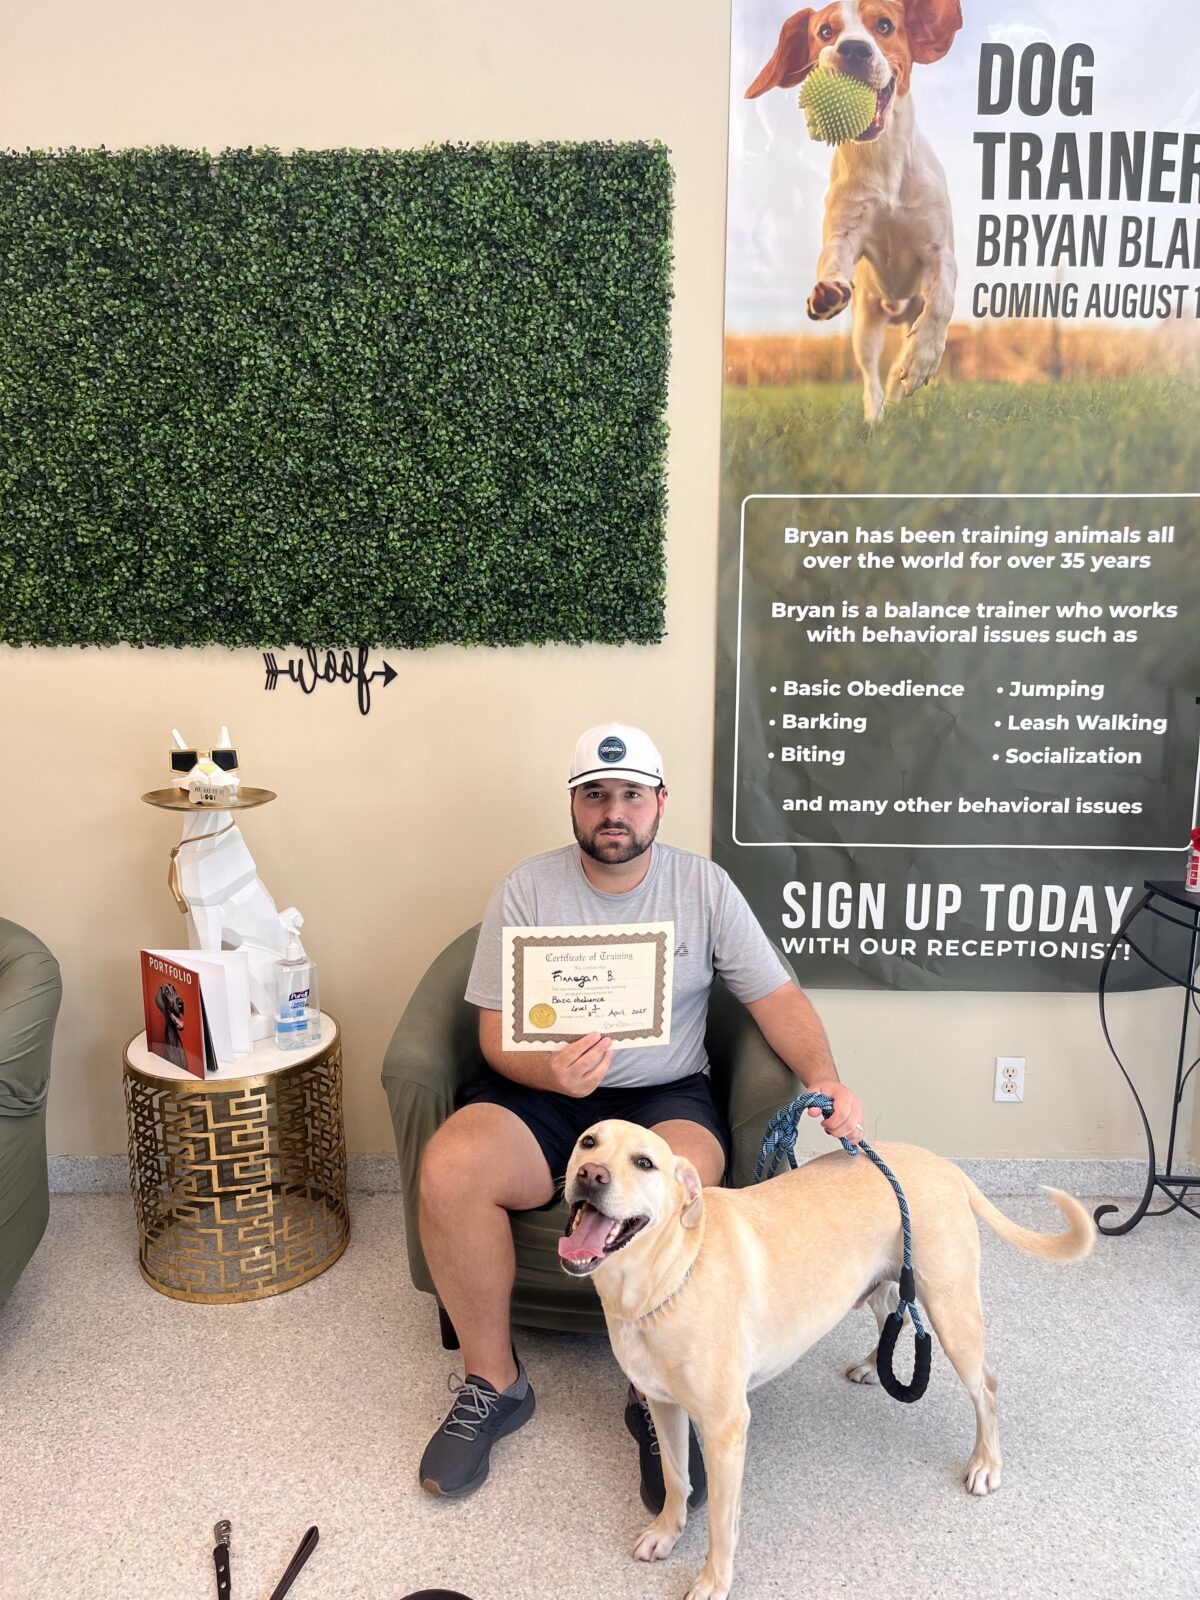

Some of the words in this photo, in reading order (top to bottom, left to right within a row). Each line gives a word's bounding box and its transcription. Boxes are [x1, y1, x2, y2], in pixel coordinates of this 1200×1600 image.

[978, 43, 1094, 116] DOG
[974, 131, 1200, 203] TRAINER
[977, 215, 1107, 266] BRYAN
[1119, 216, 1200, 268] BLA
[973, 283, 1078, 317] COMING
[1084, 284, 1189, 319] AUGUST
[785, 528, 848, 547] Bryan
[856, 527, 894, 543] has
[901, 526, 955, 543] been
[962, 525, 1048, 547] training
[1055, 525, 1141, 543] animals
[1147, 526, 1174, 543] all
[803, 556, 852, 568] over
[857, 552, 894, 568] the
[901, 552, 964, 568] world
[970, 552, 1002, 568] for
[1007, 556, 1055, 568] over
[1060, 553, 1085, 568] 35
[1090, 556, 1151, 572] years
[772, 603, 834, 621] Bryan
[842, 600, 859, 618] is
[866, 606, 877, 618] a
[885, 602, 970, 618] balance
[976, 600, 1050, 618] trainer
[1056, 602, 1103, 618] who
[1109, 602, 1177, 618] works
[807, 625, 855, 642] with
[863, 625, 977, 642] behavioral
[984, 625, 1050, 642] issues
[1056, 626, 1106, 642] such
[1113, 630, 1137, 642] as
[784, 679, 841, 696] Basic
[847, 679, 964, 696] Obedience
[1009, 680, 1104, 700] Jumping
[783, 713, 866, 733] Barking
[1009, 715, 1069, 730] Leash
[1076, 714, 1167, 734] Walking
[782, 745, 845, 765] Biting
[1006, 747, 1141, 763] Socialization
[783, 796, 822, 811] and
[829, 800, 888, 815] many
[894, 797, 952, 812] other
[958, 797, 1069, 813] behavioral
[1076, 797, 1142, 813] issues
[782, 881, 885, 929] SIGN
[906, 884, 961, 930] UP
[980, 884, 1133, 934] TODAY
[781, 938, 849, 954] WITH
[860, 938, 916, 955] OUR
[545, 952, 586, 963] Certificate
[588, 951, 597, 961] of
[599, 951, 634, 961] Training
[148, 956, 192, 985] PORTFOLIO
[551, 970, 599, 988] Finnegan
[552, 996, 572, 1004] Basic
[607, 1009, 625, 1017] April
